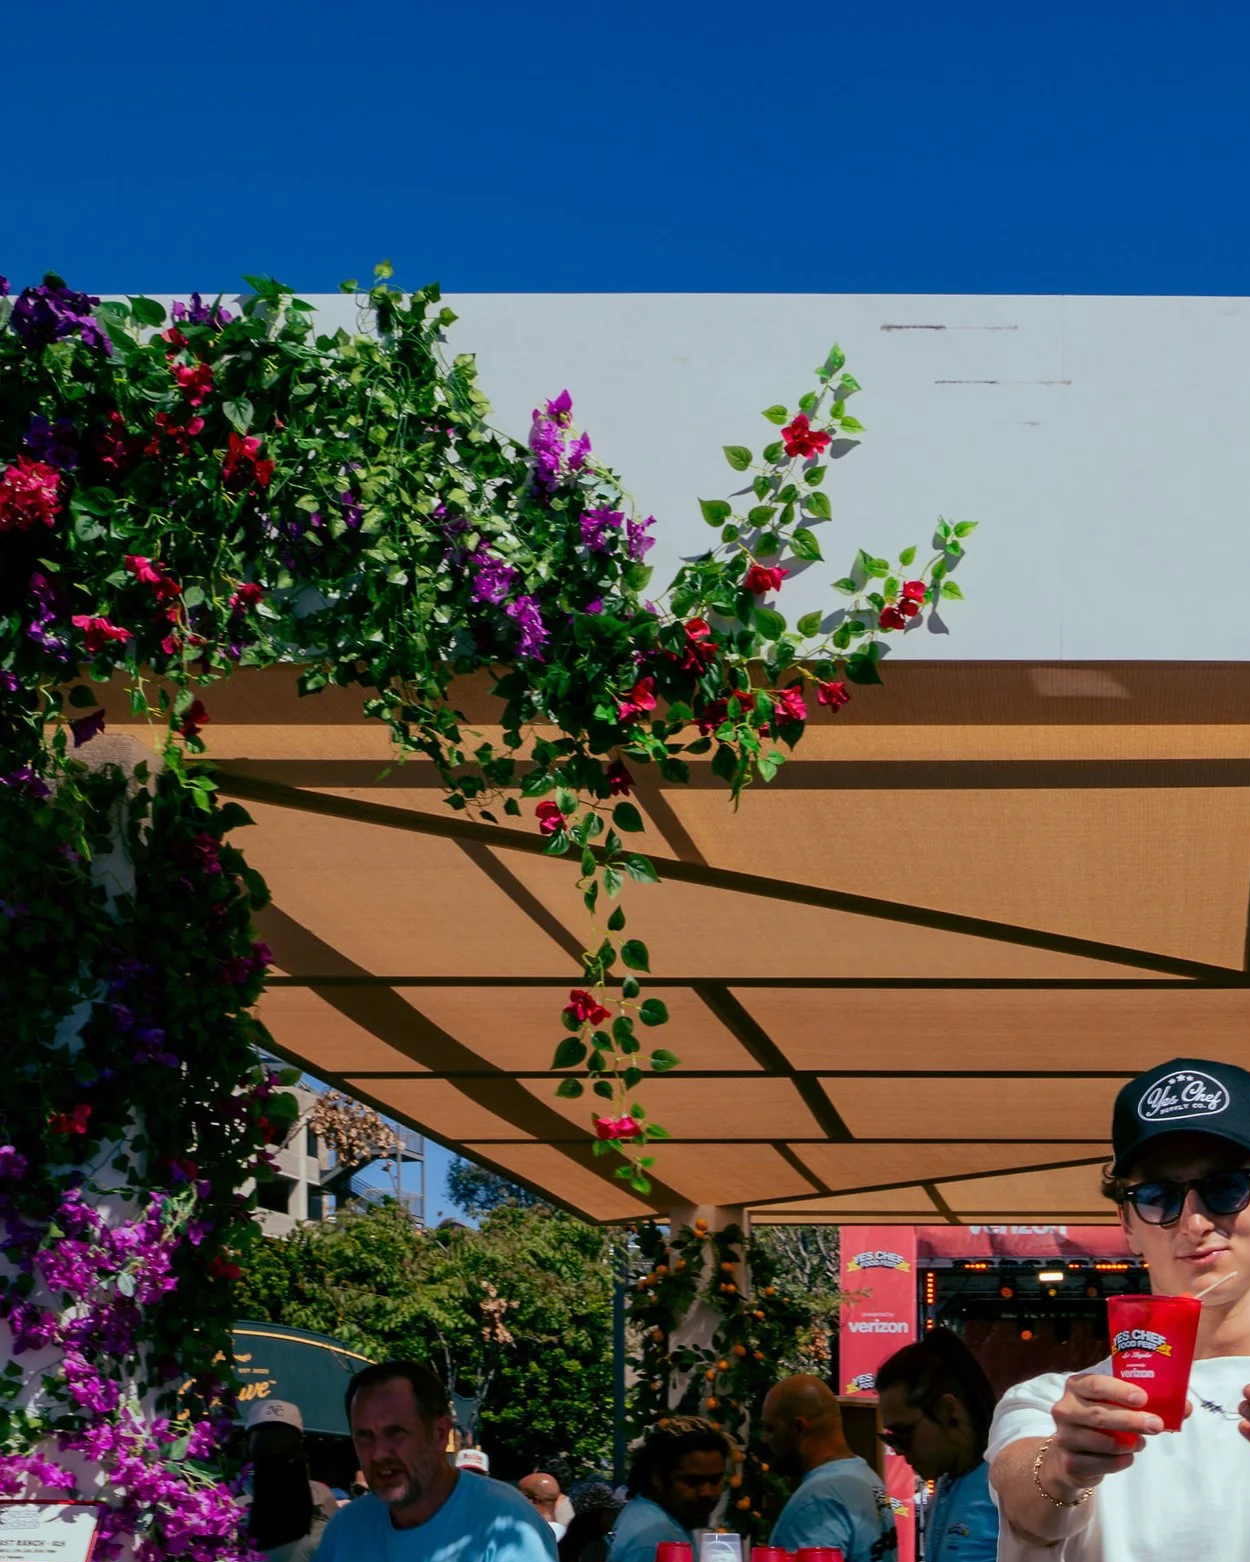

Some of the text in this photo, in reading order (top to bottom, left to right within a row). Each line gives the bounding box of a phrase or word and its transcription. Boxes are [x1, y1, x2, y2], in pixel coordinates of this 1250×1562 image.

[1145, 1080, 1223, 1117] Yes Chef
[852, 1250, 904, 1265] YES CHEF
[848, 1318, 909, 1334] verizon
[1112, 1329, 1167, 1346] YES CHEF
[1118, 1340, 1158, 1351] FOOD FEST
[851, 1373, 874, 1386] YES
[1120, 1368, 1155, 1378] verizon
